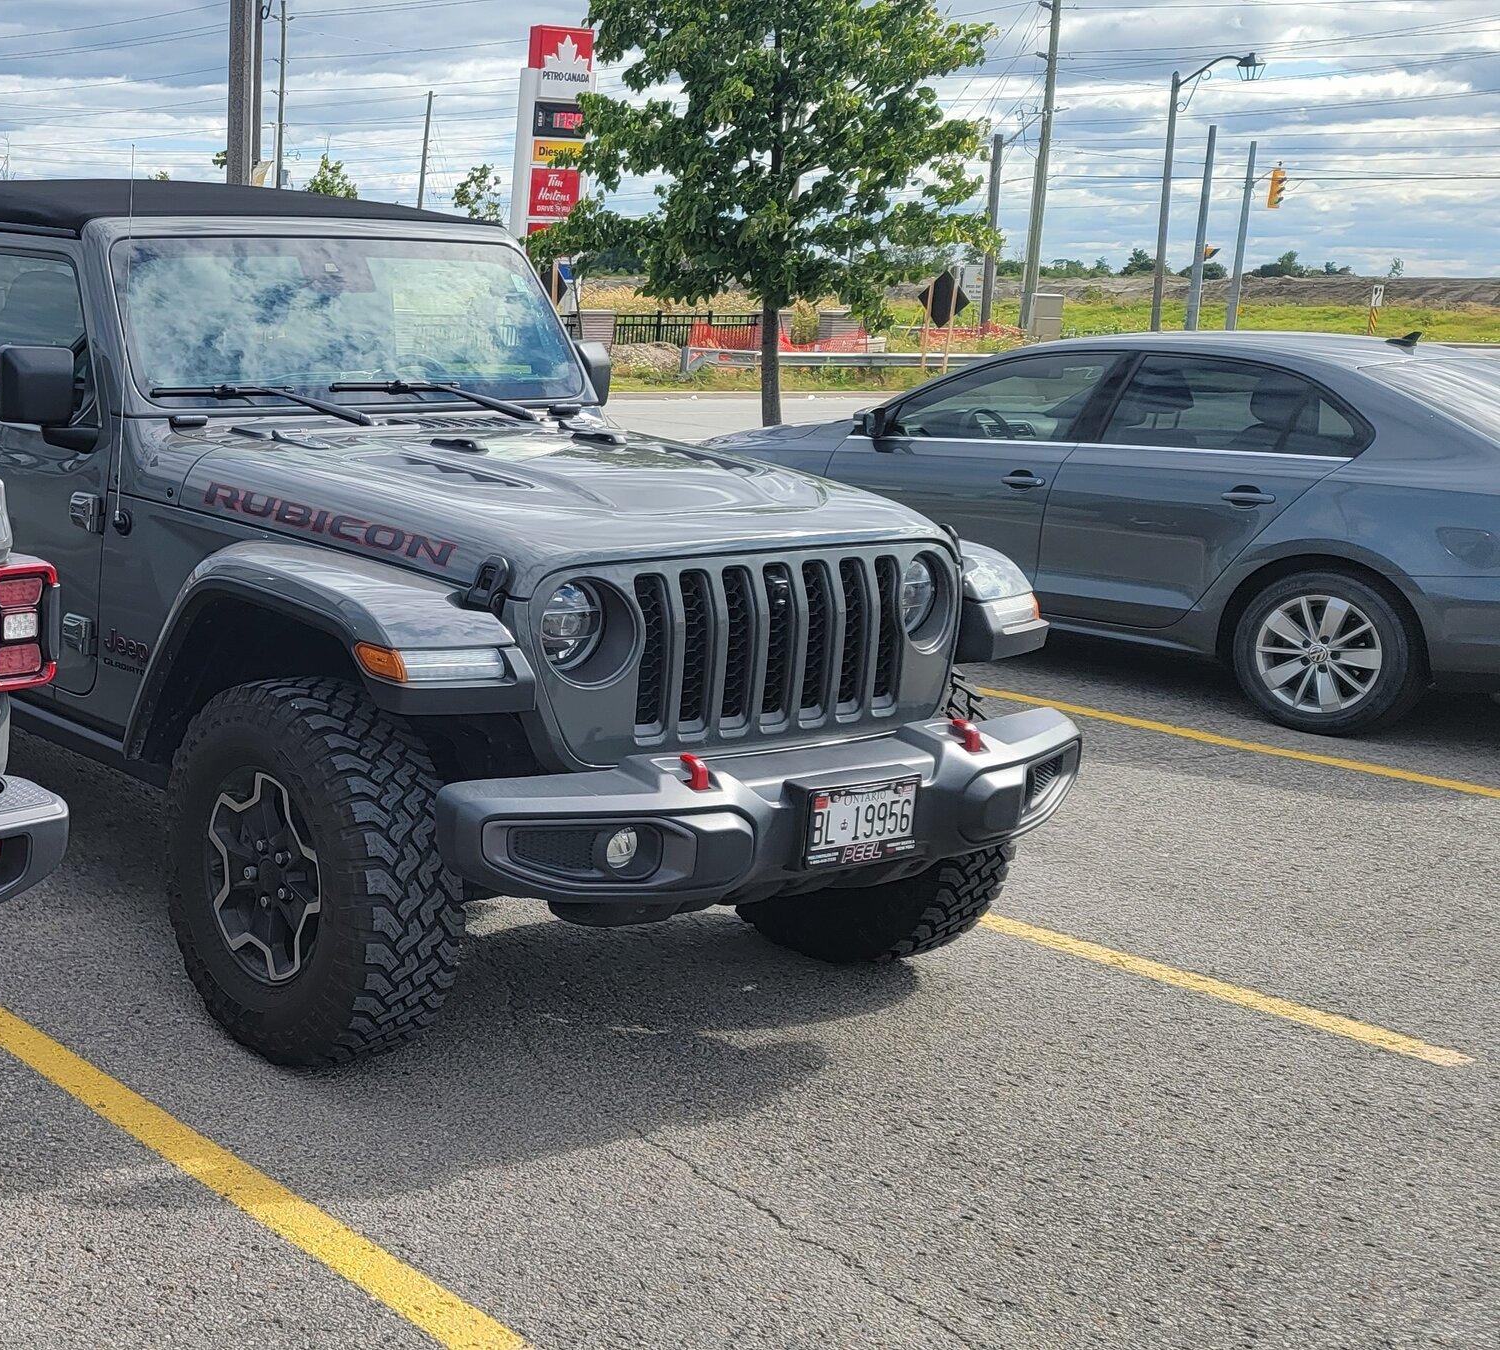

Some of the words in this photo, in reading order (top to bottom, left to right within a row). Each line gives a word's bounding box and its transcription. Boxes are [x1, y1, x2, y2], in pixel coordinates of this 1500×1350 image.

[542, 71, 590, 83] PETRO-CANADA
[548, 174, 564, 188] Tim
[537, 187, 570, 202] Hortons
[203, 480, 458, 567] RUBICON
[103, 628, 150, 664] Jeep
[103, 657, 146, 676] GLADIATO
[844, 790, 887, 806] ONTARIO
[811, 809, 836, 847] BL
[851, 798, 912, 841] 19956
[841, 842, 883, 864] PEEL
